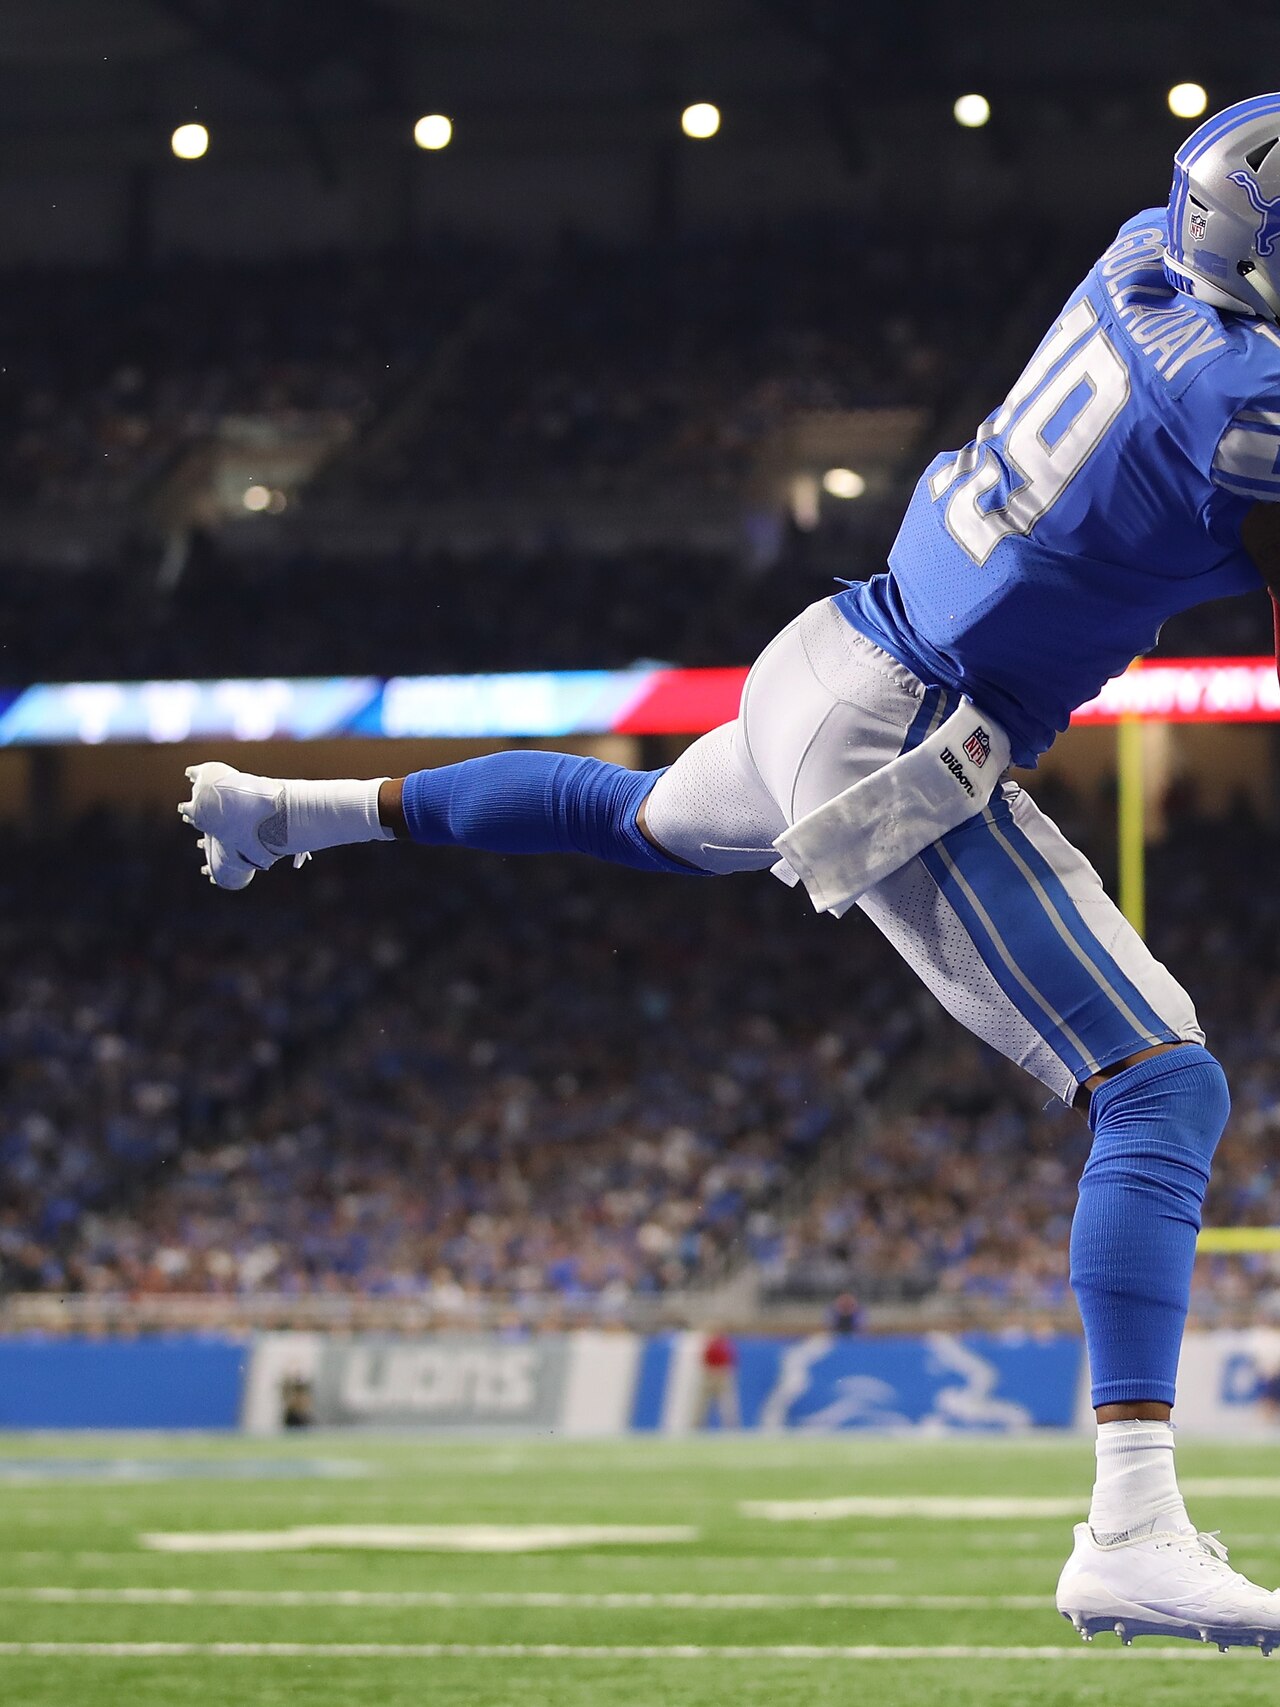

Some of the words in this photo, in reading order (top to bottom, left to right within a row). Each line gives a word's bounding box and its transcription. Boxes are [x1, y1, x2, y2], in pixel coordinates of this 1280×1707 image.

[1101, 228, 1226, 382] GOLLADAY
[929, 294, 1132, 568] 19
[940, 747, 973, 795] Wilson
